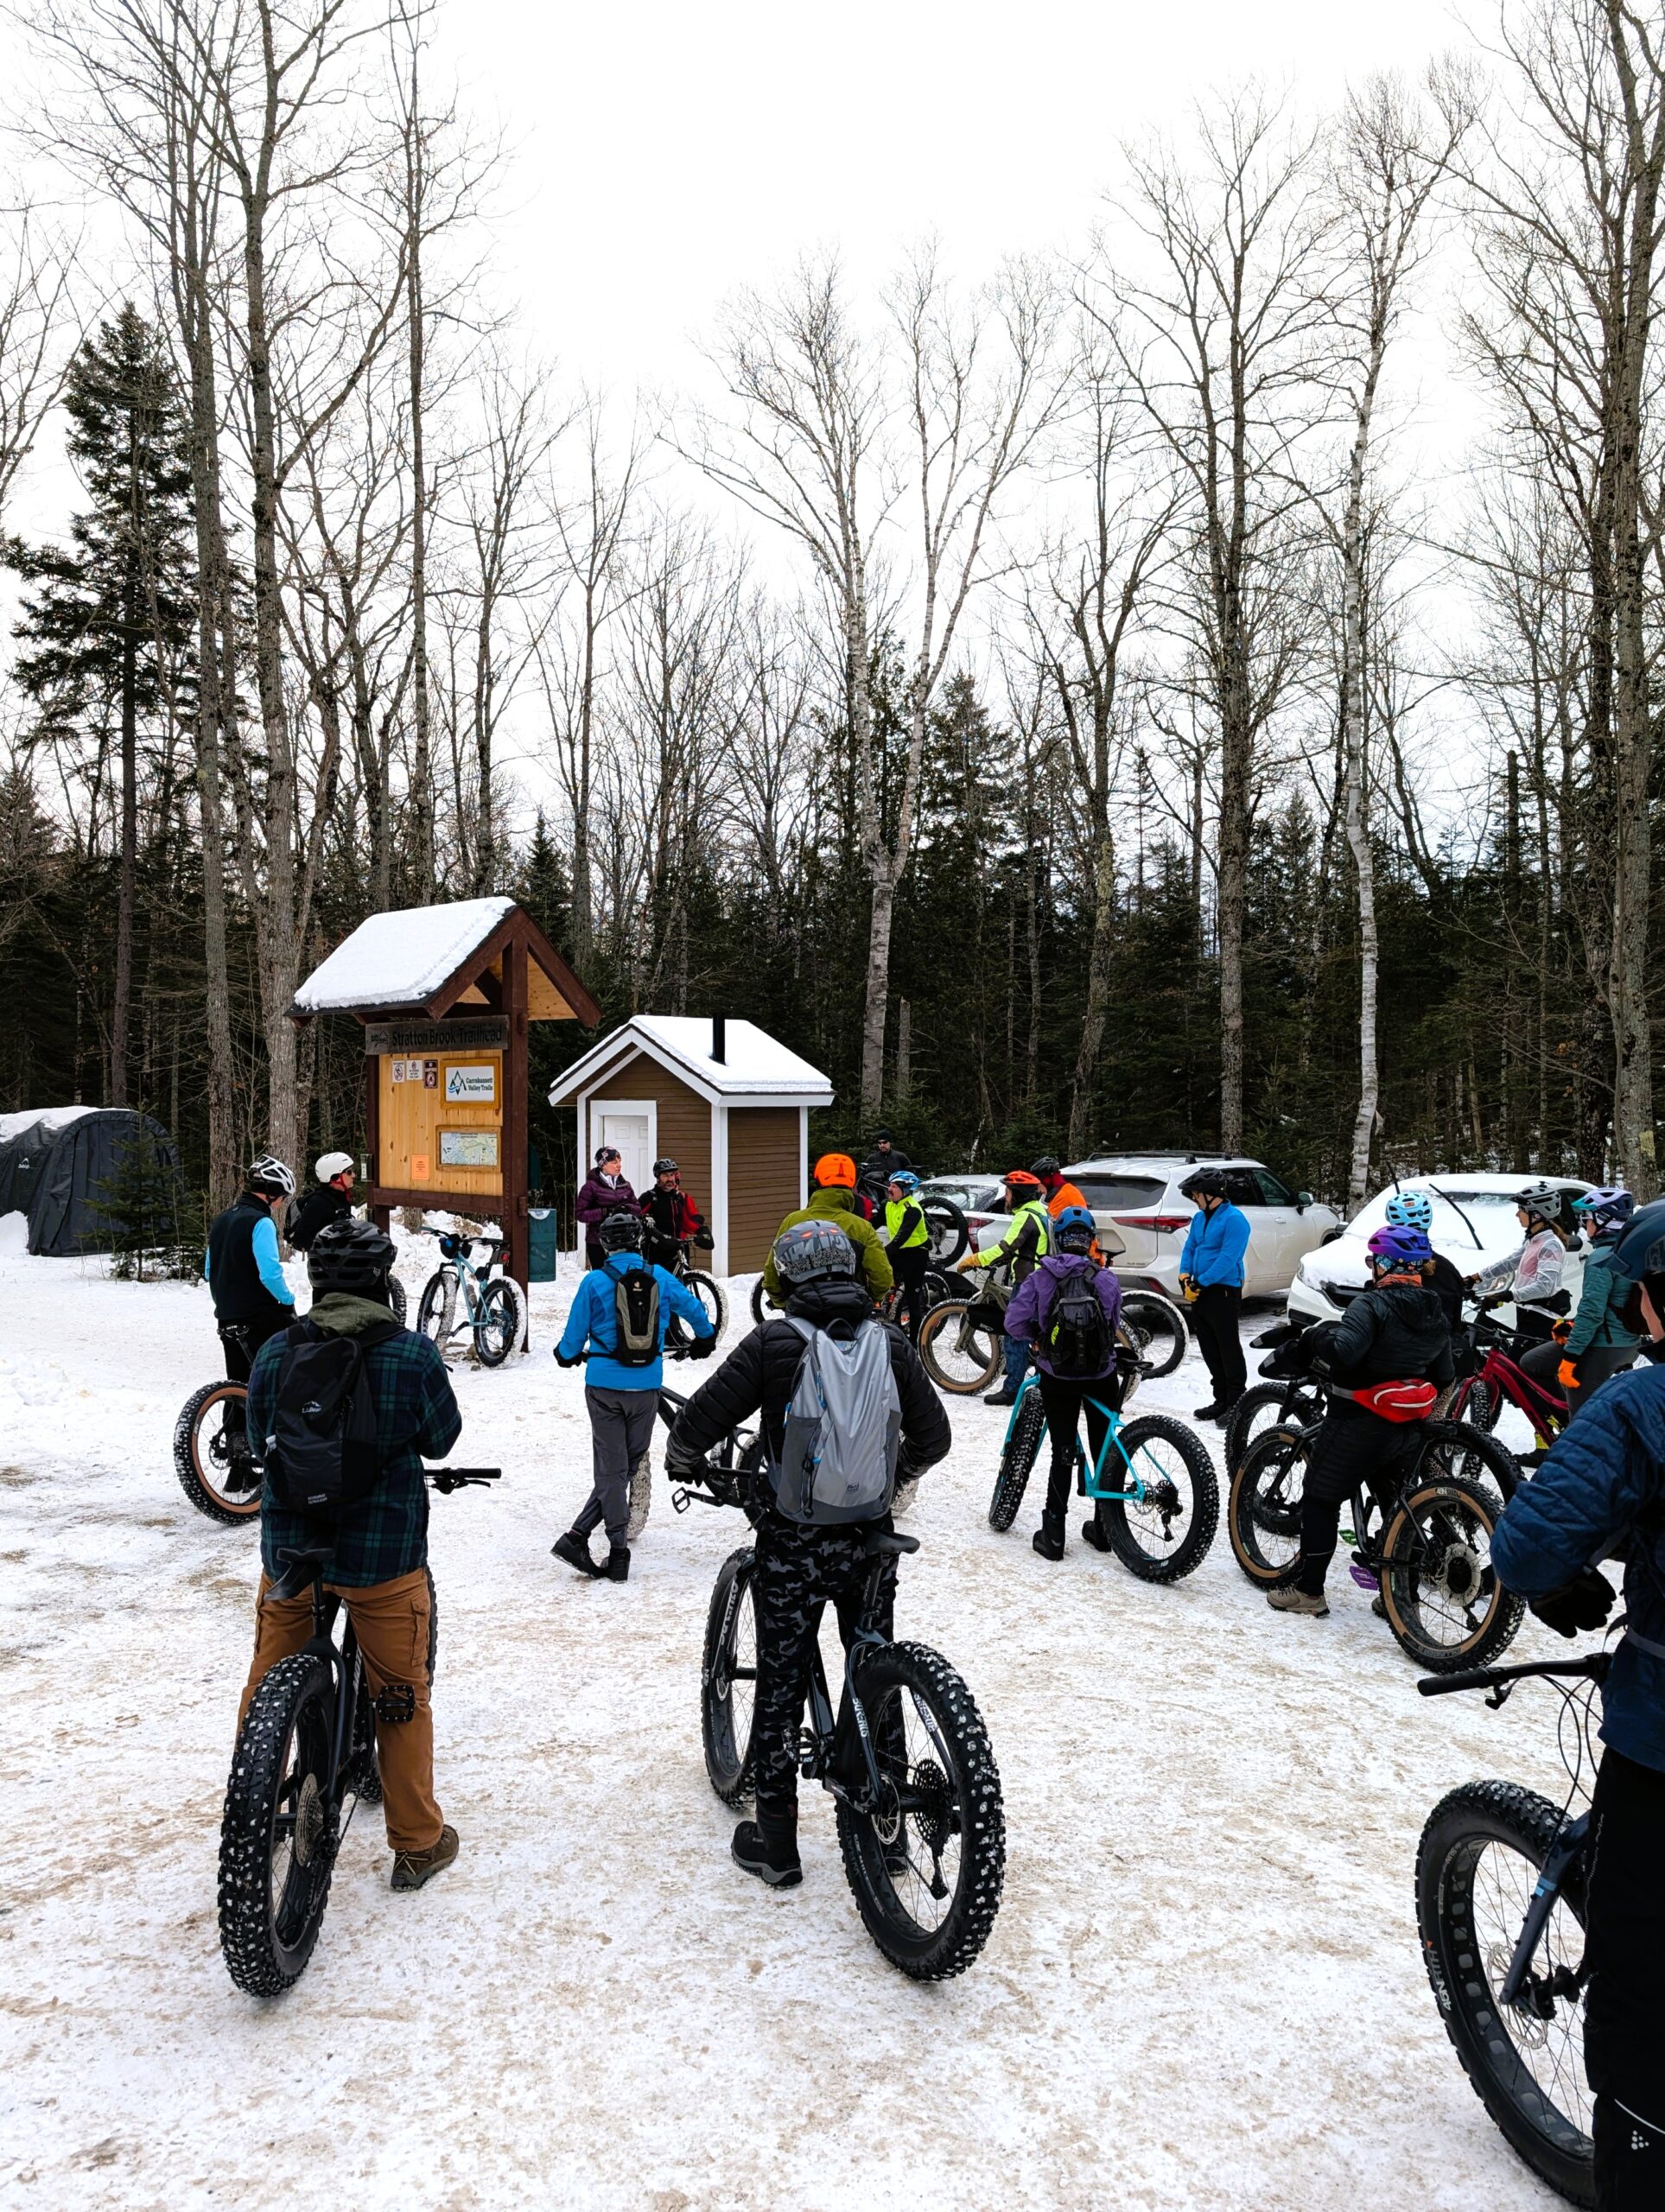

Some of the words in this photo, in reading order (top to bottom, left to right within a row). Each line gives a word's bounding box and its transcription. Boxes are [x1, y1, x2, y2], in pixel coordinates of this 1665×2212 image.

[392, 1029, 428, 1046] Stratton
[429, 1027, 455, 1045] Brook
[459, 1022, 502, 1044] Trailhead
[1428, 1949, 1452, 2011] 45NRTH
